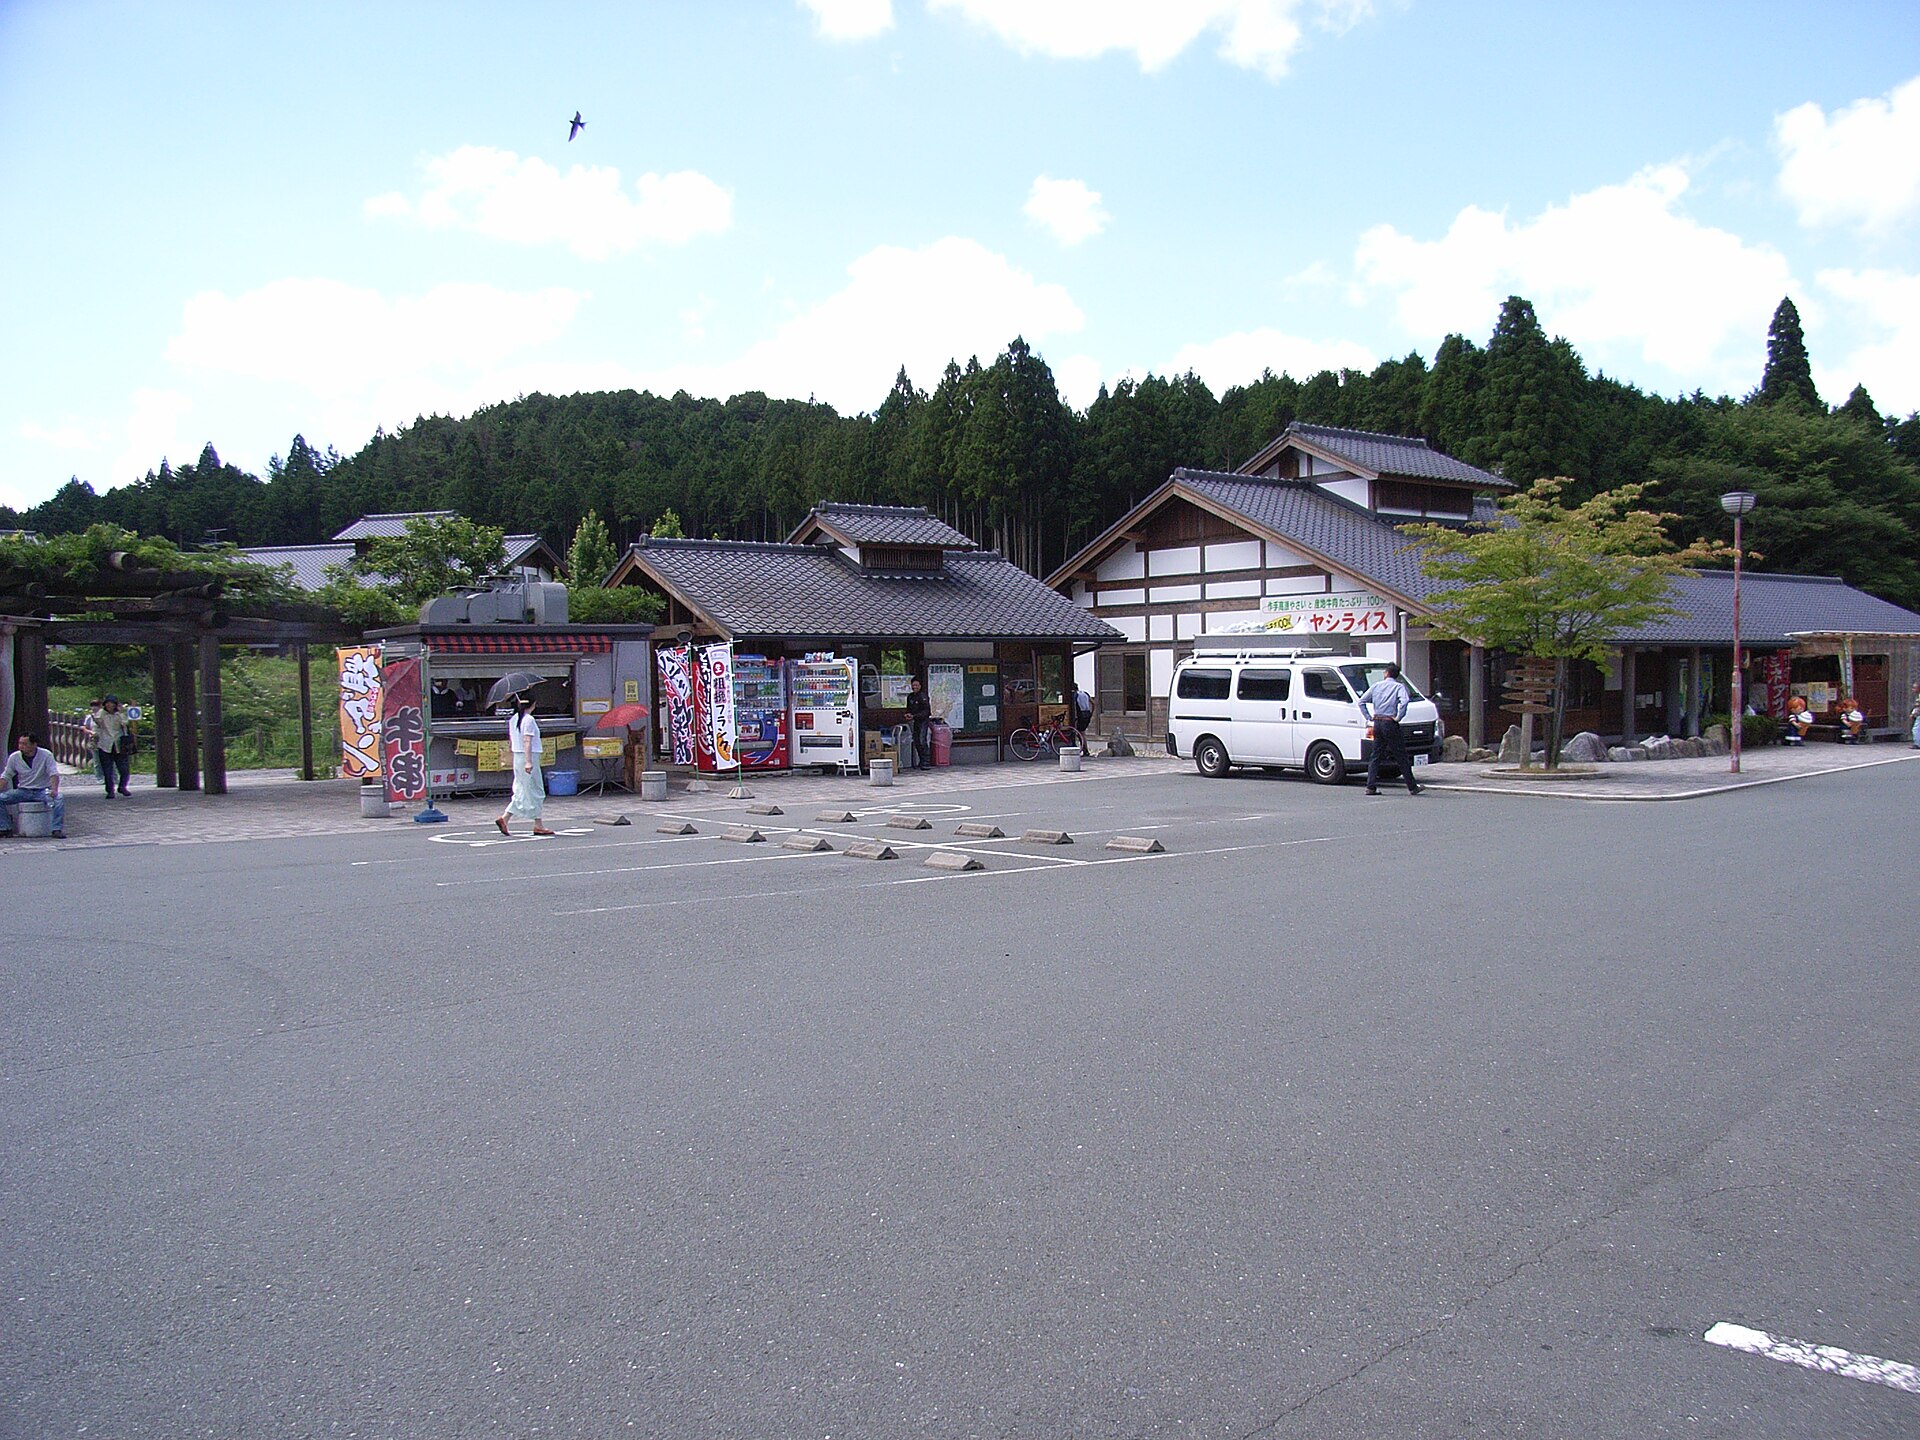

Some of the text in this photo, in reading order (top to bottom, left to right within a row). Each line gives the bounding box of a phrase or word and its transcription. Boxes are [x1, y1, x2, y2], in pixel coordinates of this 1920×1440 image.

[1297, 611, 1388, 632] ヤシライス
